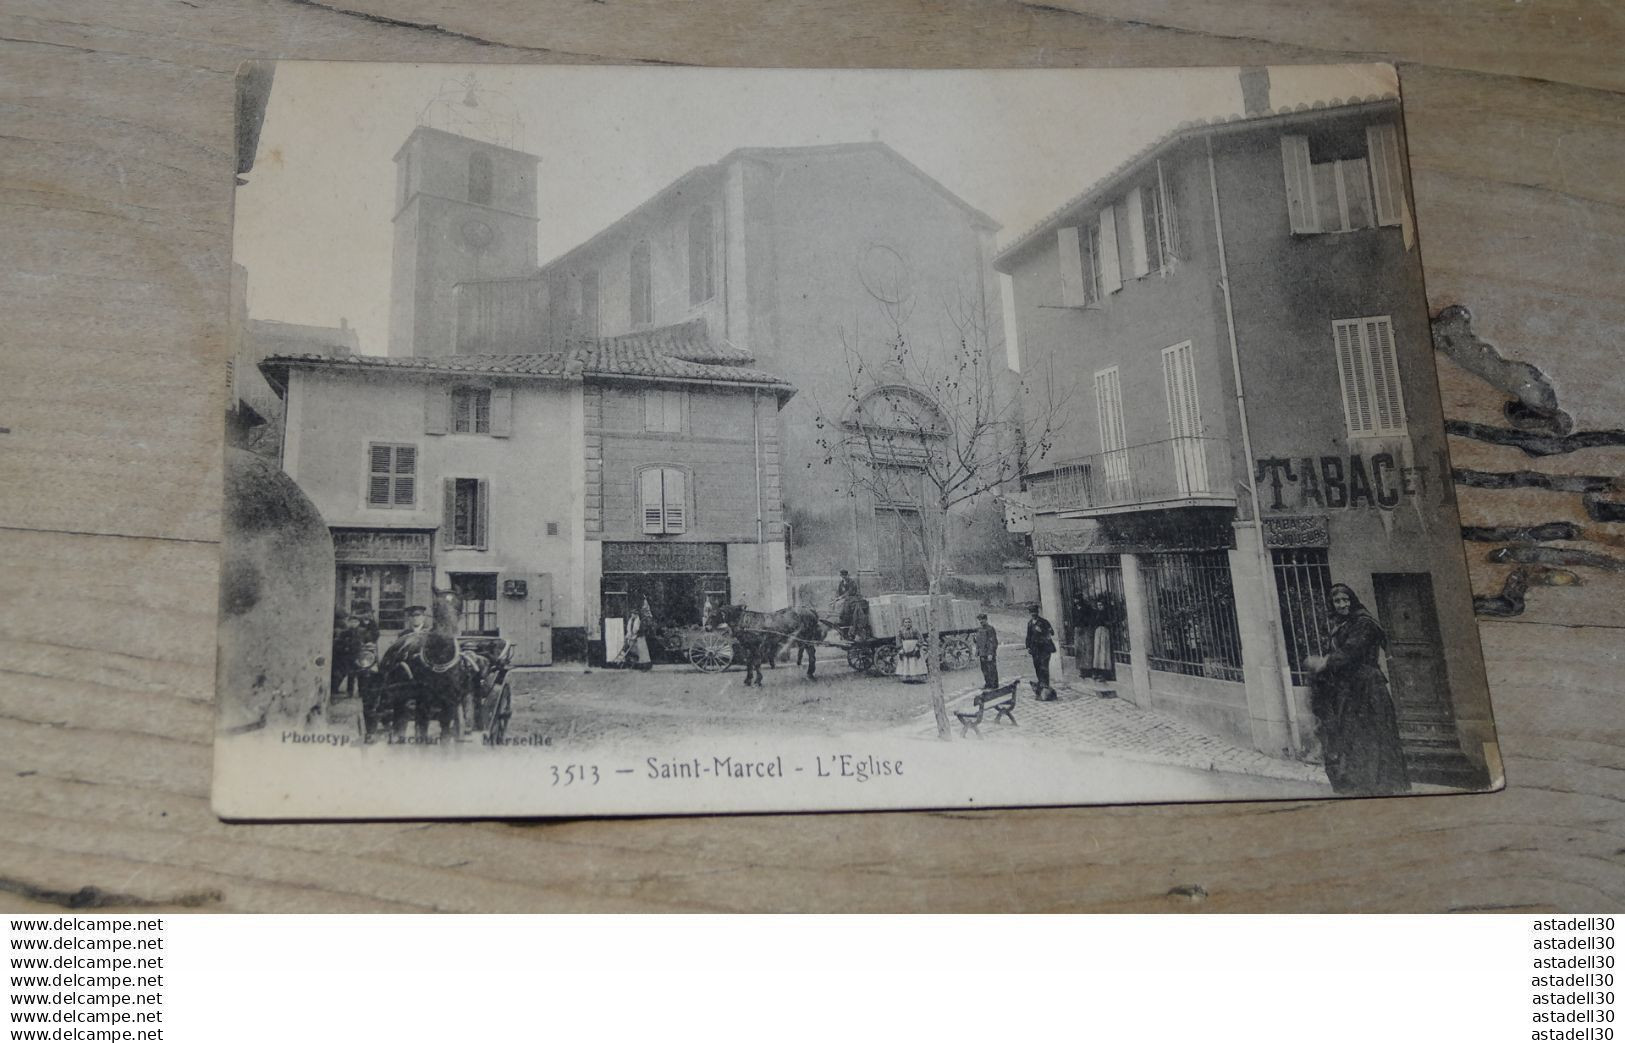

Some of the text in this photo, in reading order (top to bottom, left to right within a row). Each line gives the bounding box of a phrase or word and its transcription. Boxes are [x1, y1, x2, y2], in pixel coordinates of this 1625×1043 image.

[1254, 452, 1397, 509] TABAC
[549, 754, 904, 786] 3513 Saint-Marcel L'Eglise
